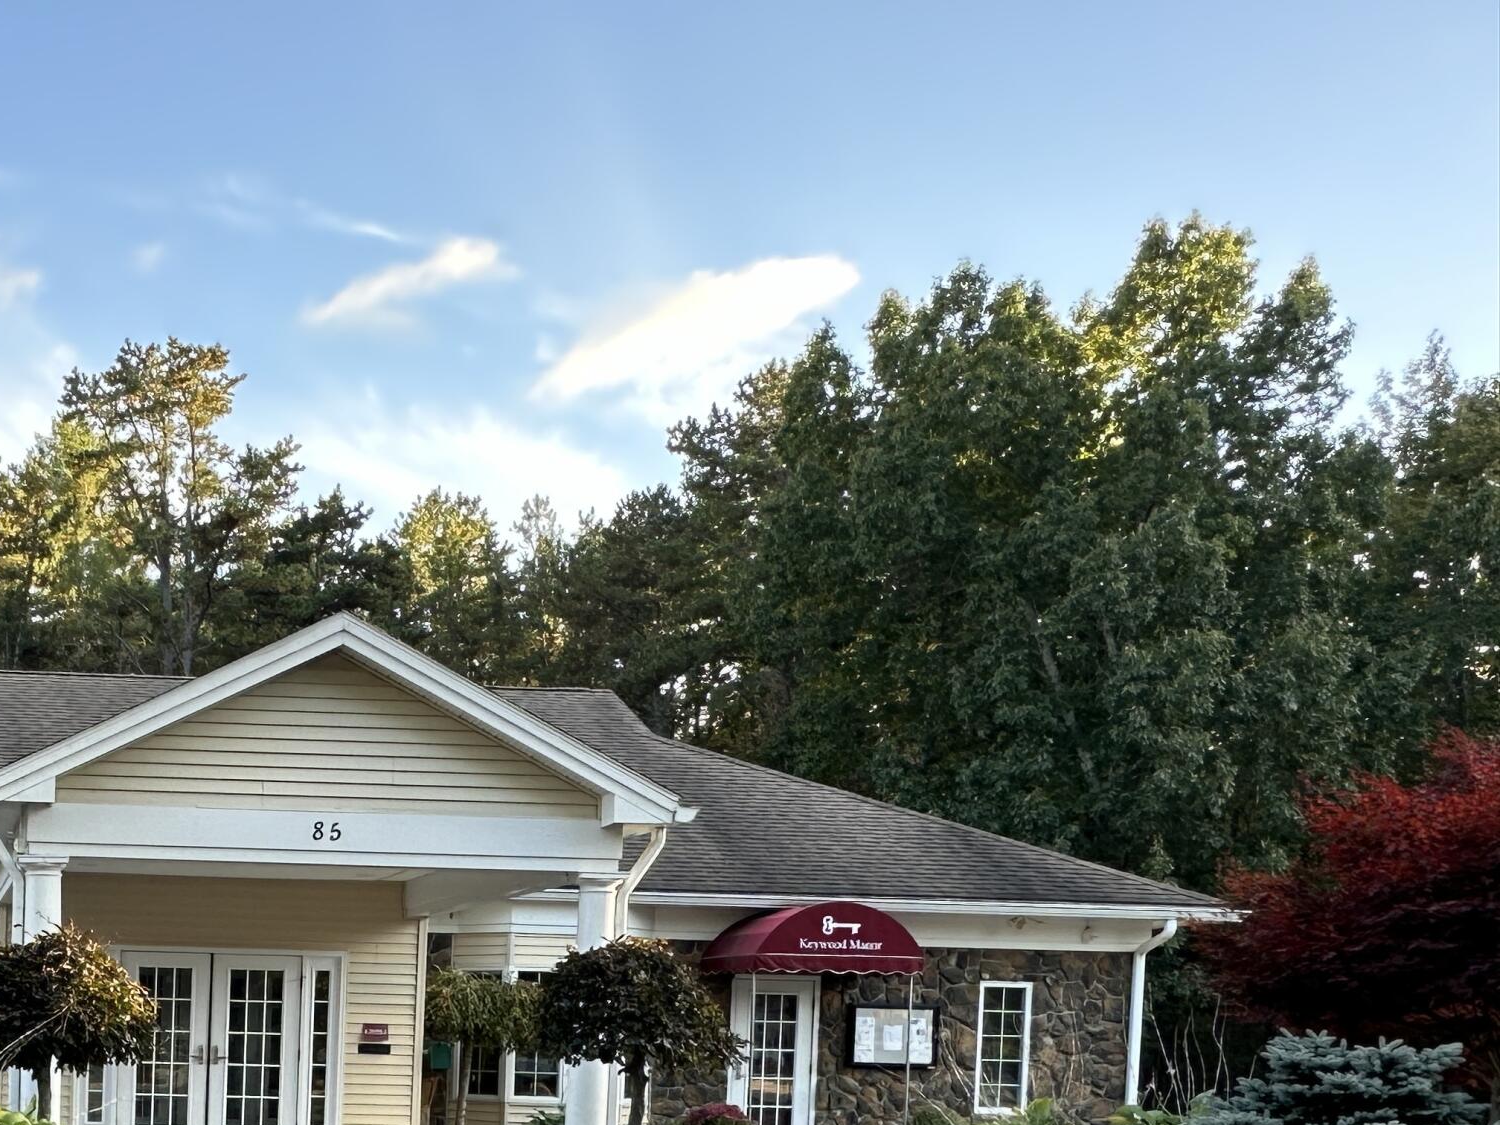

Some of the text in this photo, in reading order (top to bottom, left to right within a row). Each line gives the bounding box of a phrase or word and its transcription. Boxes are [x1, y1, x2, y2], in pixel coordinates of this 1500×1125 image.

[312, 821, 342, 841] 85
[799, 937, 883, 951] Keywood Manor
